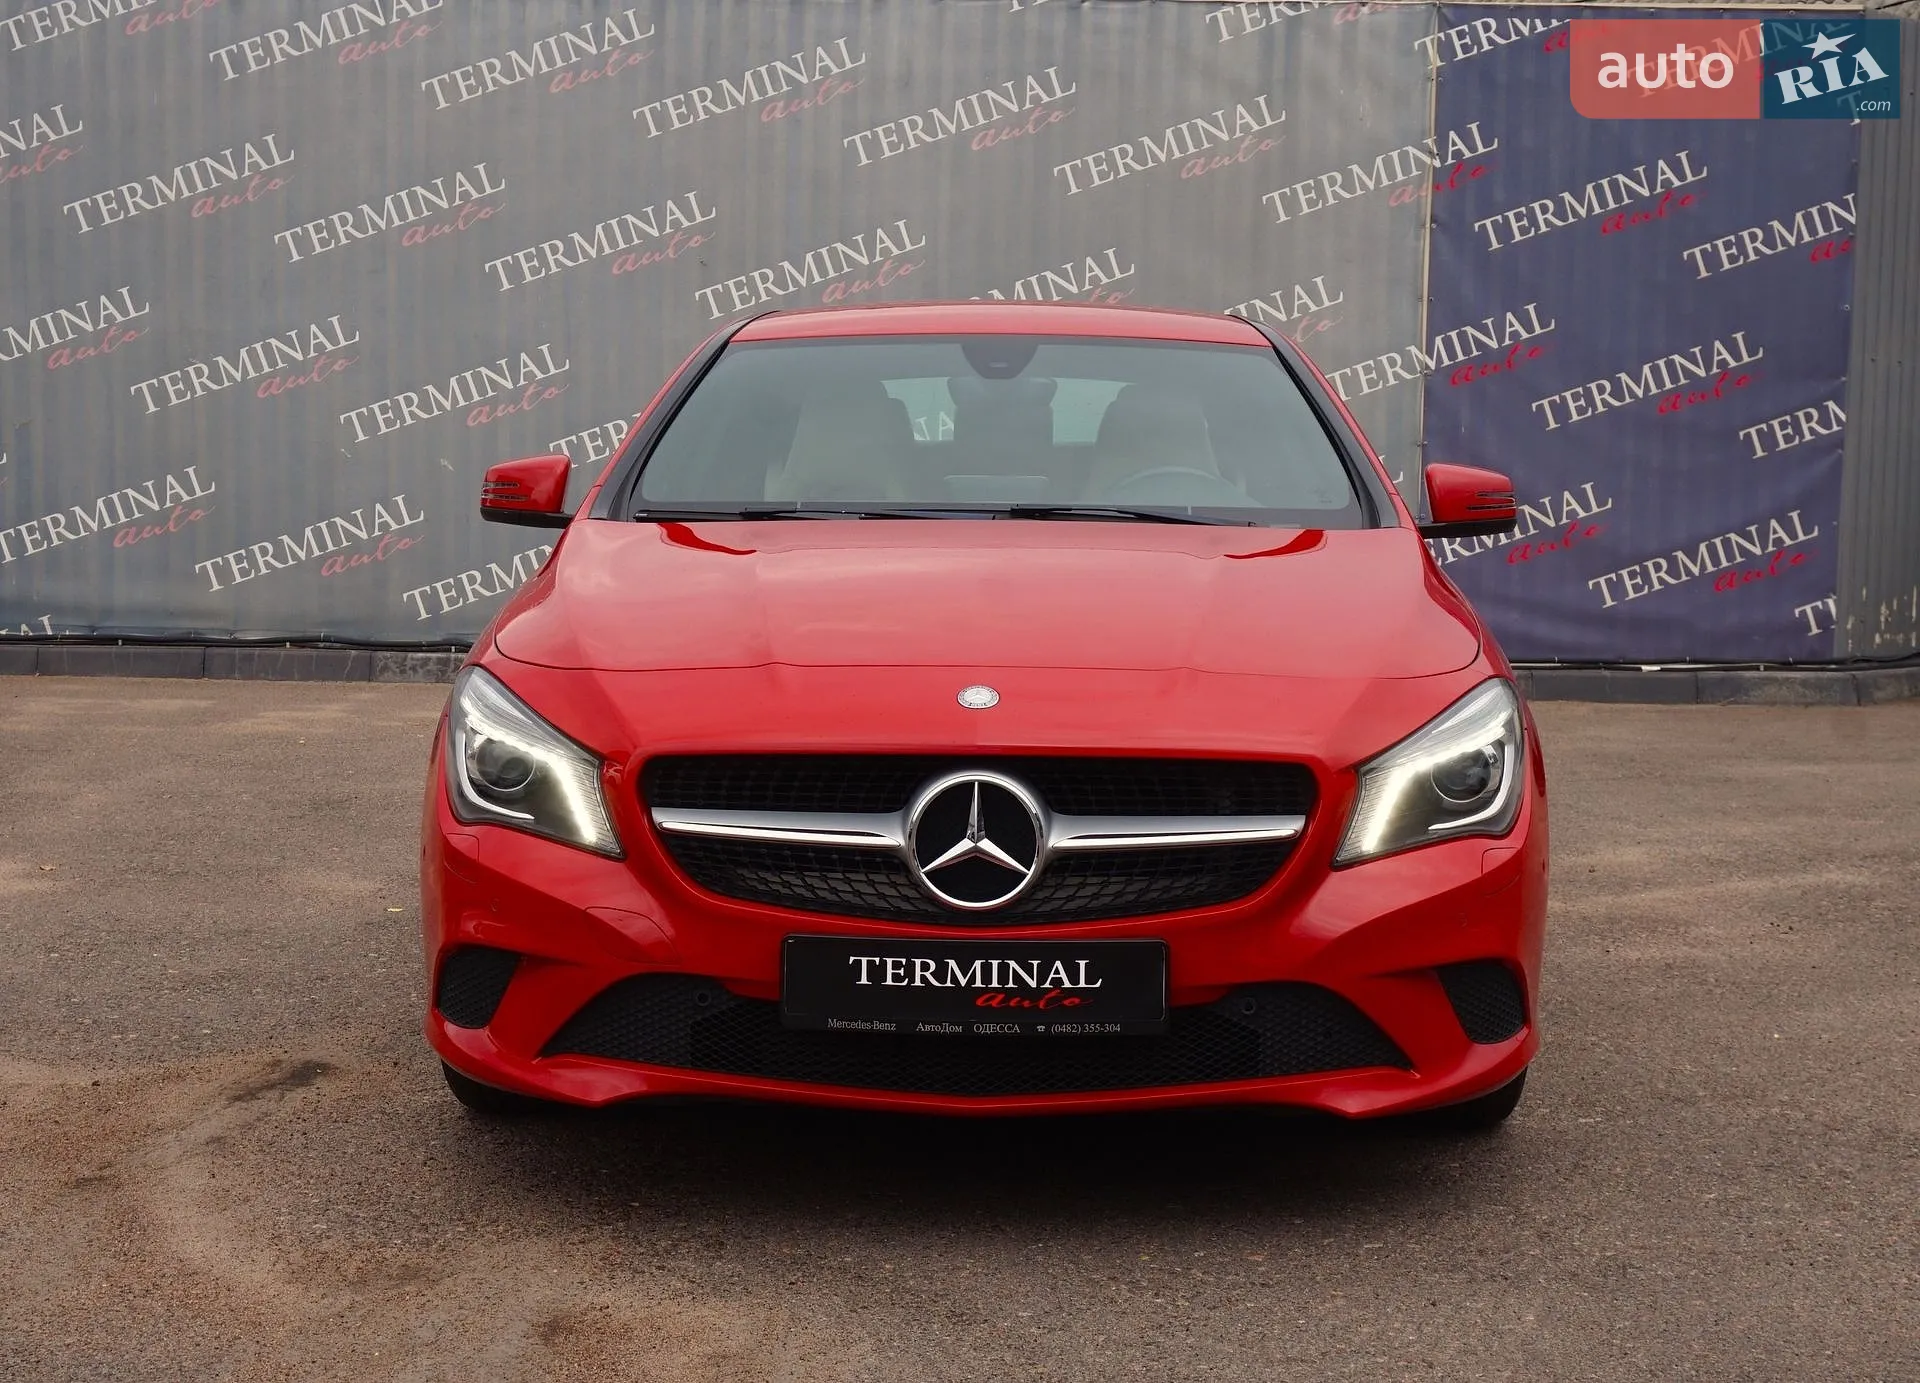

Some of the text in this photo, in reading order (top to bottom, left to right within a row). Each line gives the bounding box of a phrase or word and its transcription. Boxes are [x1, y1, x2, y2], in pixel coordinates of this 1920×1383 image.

[0, 0, 157, 51] TERM
[338, 21, 443, 65] auto
[1414, 18, 1571, 69] TERM
[421, 8, 654, 110] TERMINAL
[549, 47, 654, 94] auto
[633, 37, 866, 138] TERMINAL
[760, 75, 865, 122] auto
[843, 66, 1076, 167] TERMINAL
[970, 106, 1075, 151] auto
[1053, 94, 1286, 196] TERMINAL
[1180, 135, 1286, 179] auto
[64, 133, 295, 234] TERMINAL
[191, 173, 295, 218] auto
[1263, 121, 1498, 224] TERMINAL
[274, 162, 506, 263] TERMINAL
[1474, 150, 1708, 252] TERMINAL
[1600, 190, 1706, 235] auto
[402, 203, 506, 247] auto
[485, 191, 717, 292] TERMINAL
[612, 230, 716, 275] auto
[695, 219, 926, 320] TERMINAL
[822, 259, 926, 304] auto
[0, 286, 150, 361] MINAL
[47, 325, 149, 371] auto
[130, 313, 360, 415] TERMINAL
[1326, 303, 1555, 401] TERMINAL
[1449, 342, 1552, 387] auto
[256, 355, 360, 399] auto
[340, 343, 570, 444] TERMINAL
[1532, 331, 1764, 432] TERMINAL
[1656, 370, 1760, 415] auto
[466, 384, 570, 428] auto
[0, 465, 215, 564] TERMINAL
[112, 504, 216, 548] auto
[195, 494, 425, 593] TERMINAL
[320, 533, 425, 577] auto
[1506, 519, 1608, 563] auto
[1588, 510, 1819, 609] TERMINAL
[403, 545, 553, 621] TERMI
[1713, 548, 1816, 593] auto
[849, 956, 1102, 988] TERMINAL
[975, 989, 1092, 1009] auto
[828, 1018, 1121, 1034] Mercedes-Benz АвтоДом ОДЕССА (0482) 355-304
